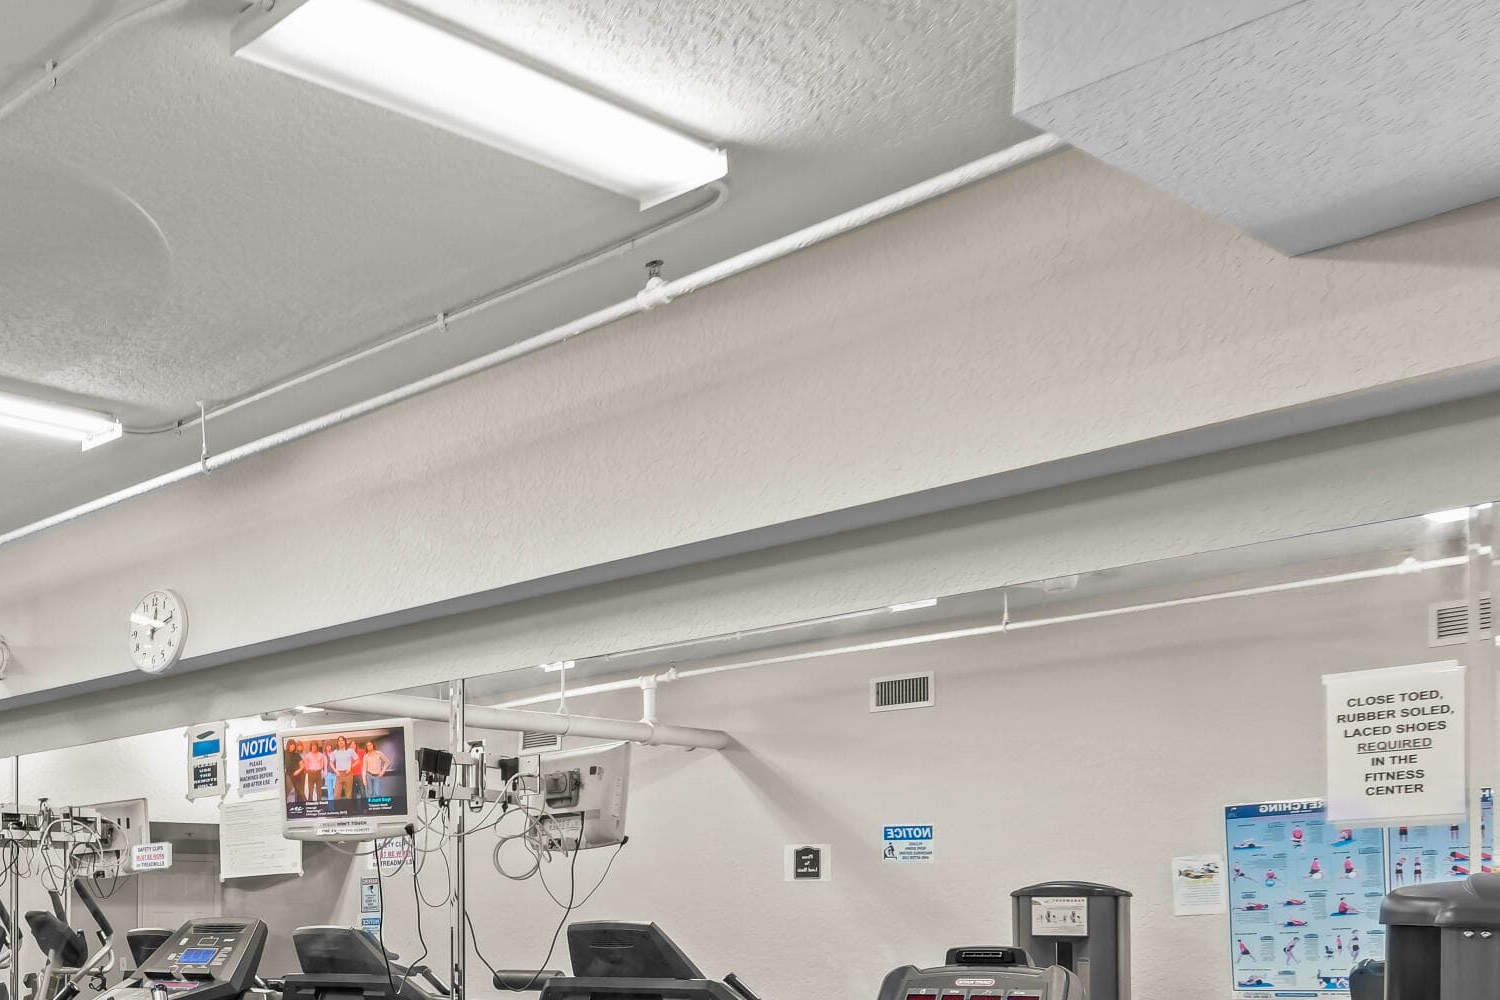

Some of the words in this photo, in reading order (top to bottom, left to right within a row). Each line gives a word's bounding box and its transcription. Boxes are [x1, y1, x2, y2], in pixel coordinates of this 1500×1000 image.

[1347, 694, 1395, 708] CLOSE
[1399, 689, 1444, 702] TOED,
[1337, 709, 1396, 724] RUBBER
[1400, 704, 1455, 718] SOLED,
[1344, 725, 1392, 739] LACED
[1396, 720, 1447, 734] SHOES
[241, 736, 277, 757] NOTIC
[1357, 737, 1432, 753] REQUIRED
[1371, 756, 1385, 766] IN
[1389, 754, 1418, 765] THE
[1365, 769, 1425, 782] FITNESS
[1365, 783, 1424, 796] CENTER
